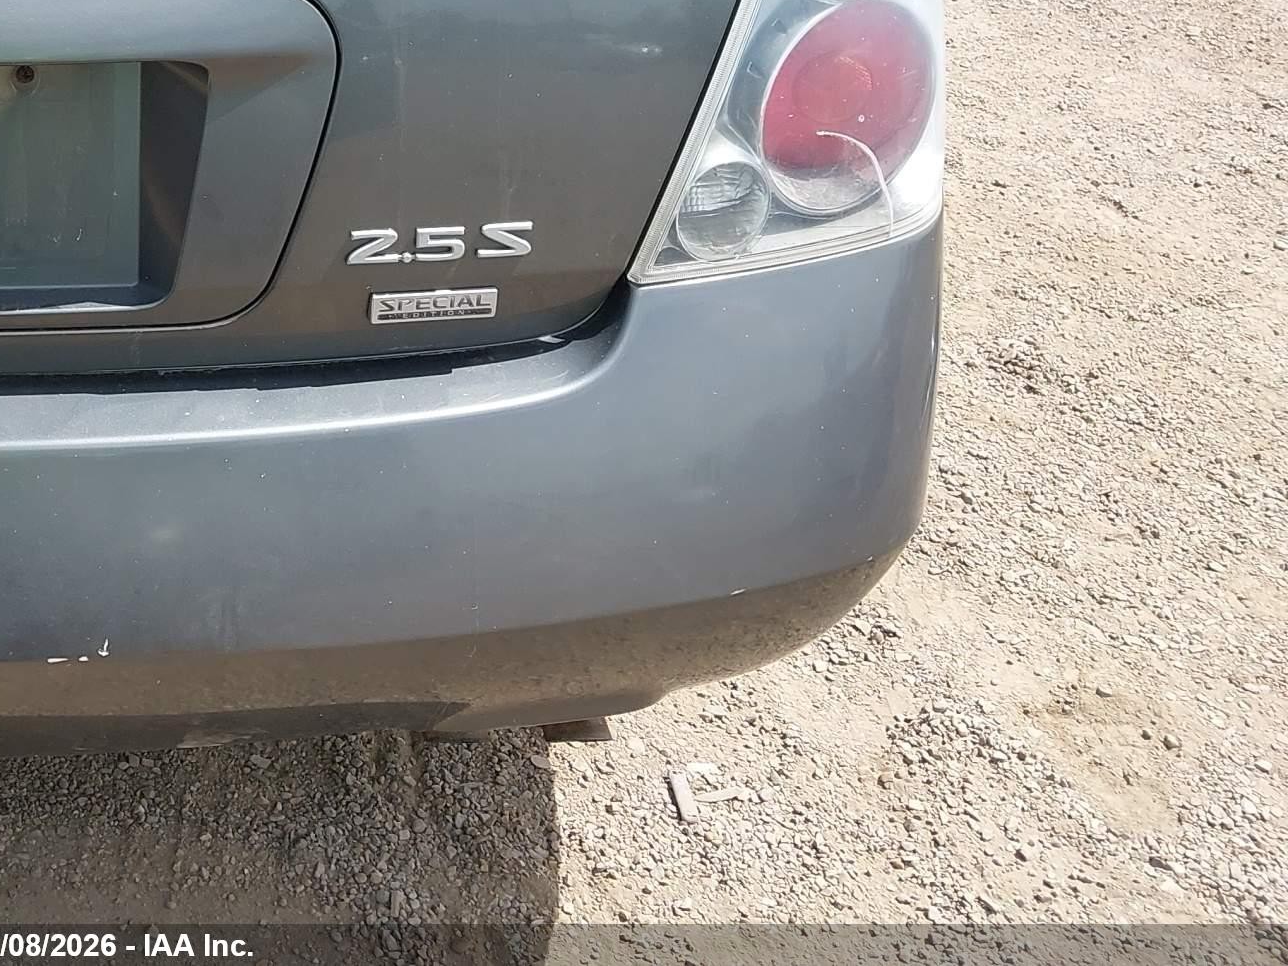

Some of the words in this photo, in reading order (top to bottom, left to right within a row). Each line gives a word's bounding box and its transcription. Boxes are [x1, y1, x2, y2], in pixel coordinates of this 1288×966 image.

[346, 226, 466, 266] 2.5
[475, 220, 534, 258] S
[378, 295, 491, 313] SPECIAL
[402, 309, 465, 319] EDITION
